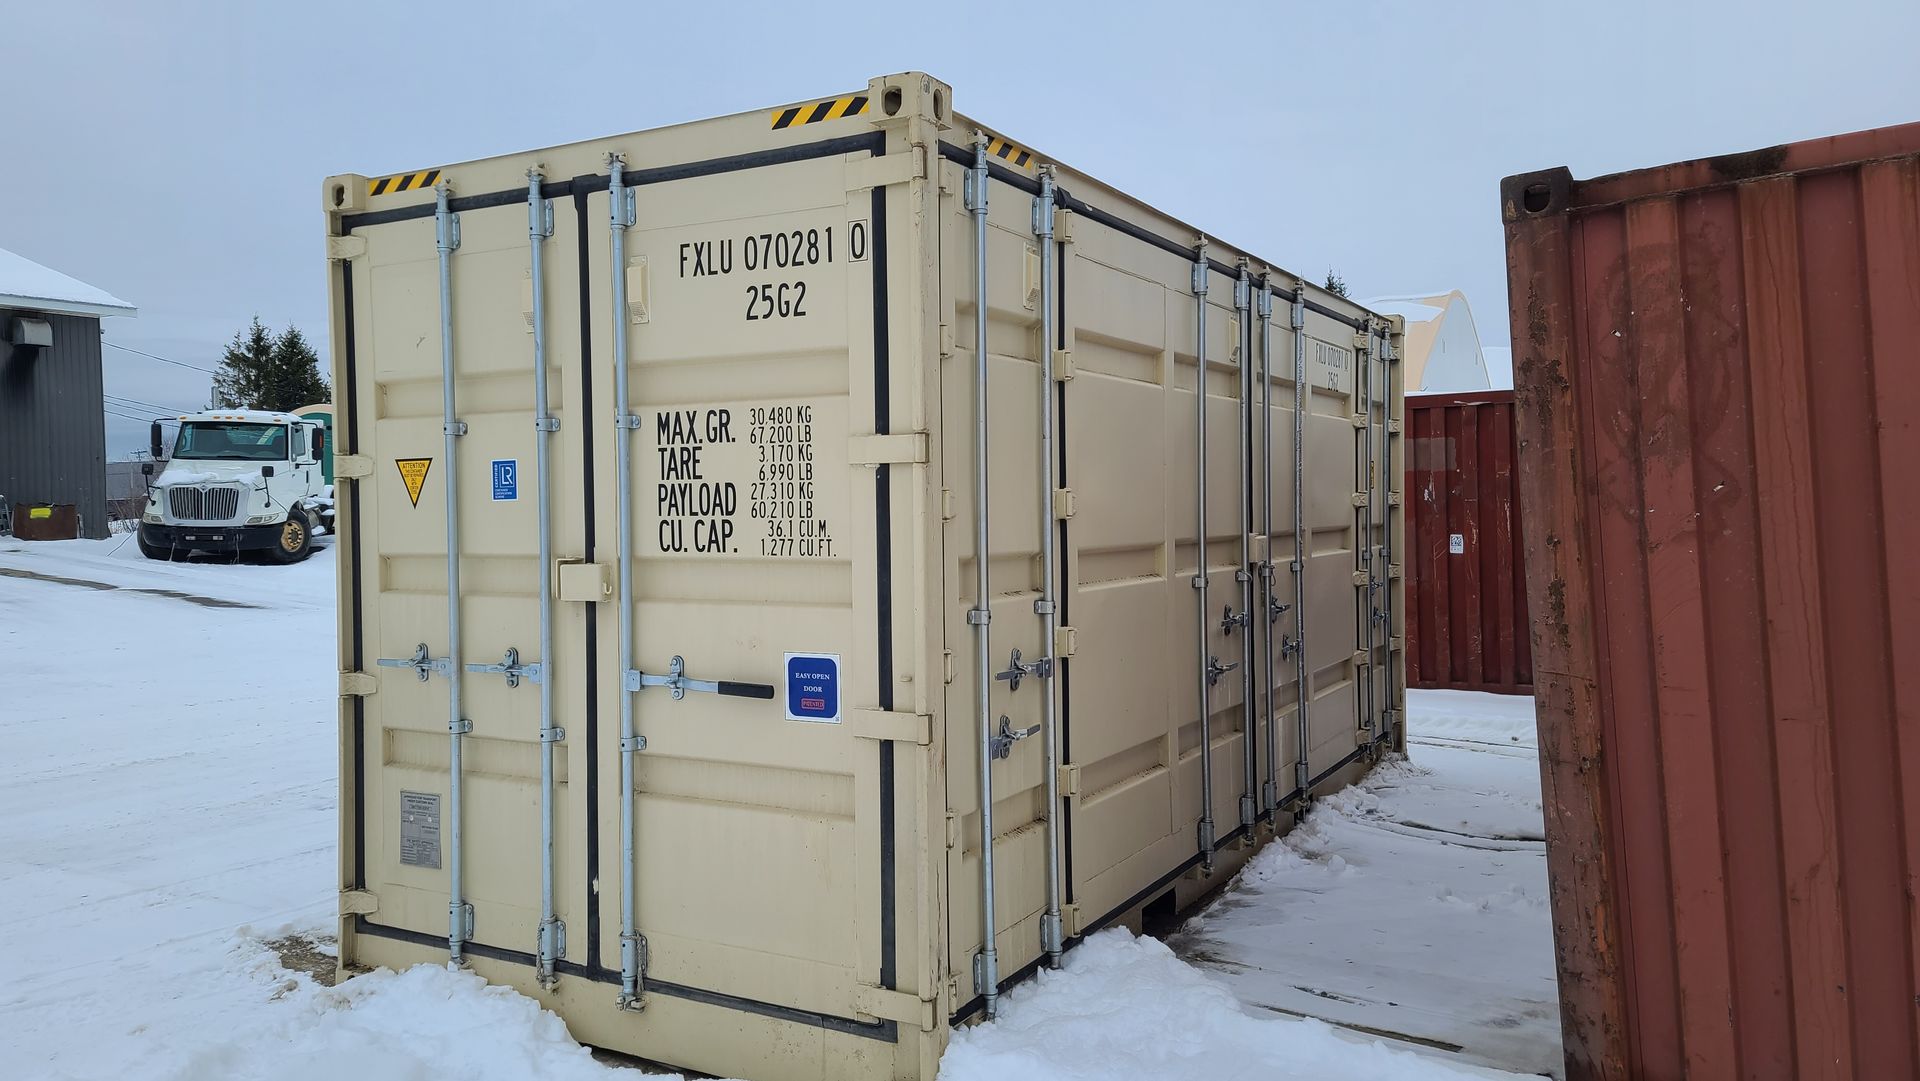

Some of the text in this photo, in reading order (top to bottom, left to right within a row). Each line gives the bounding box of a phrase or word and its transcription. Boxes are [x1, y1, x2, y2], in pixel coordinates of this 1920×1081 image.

[679, 222, 866, 278] FXLU 070281 0
[746, 281, 807, 321] 25G2
[797, 405, 812, 424] KG
[797, 424, 812, 443] LB
[798, 443, 813, 462] KG
[658, 446, 703, 481] TARE
[798, 463, 813, 481] LB
[658, 482, 737, 517] PAYLOAD
[799, 481, 814, 500] KG
[799, 500, 813, 519] LB
[659, 519, 738, 553] CU. CAP.
[767, 520, 793, 538] 36.1
[803, 685, 823, 693] DOOR
